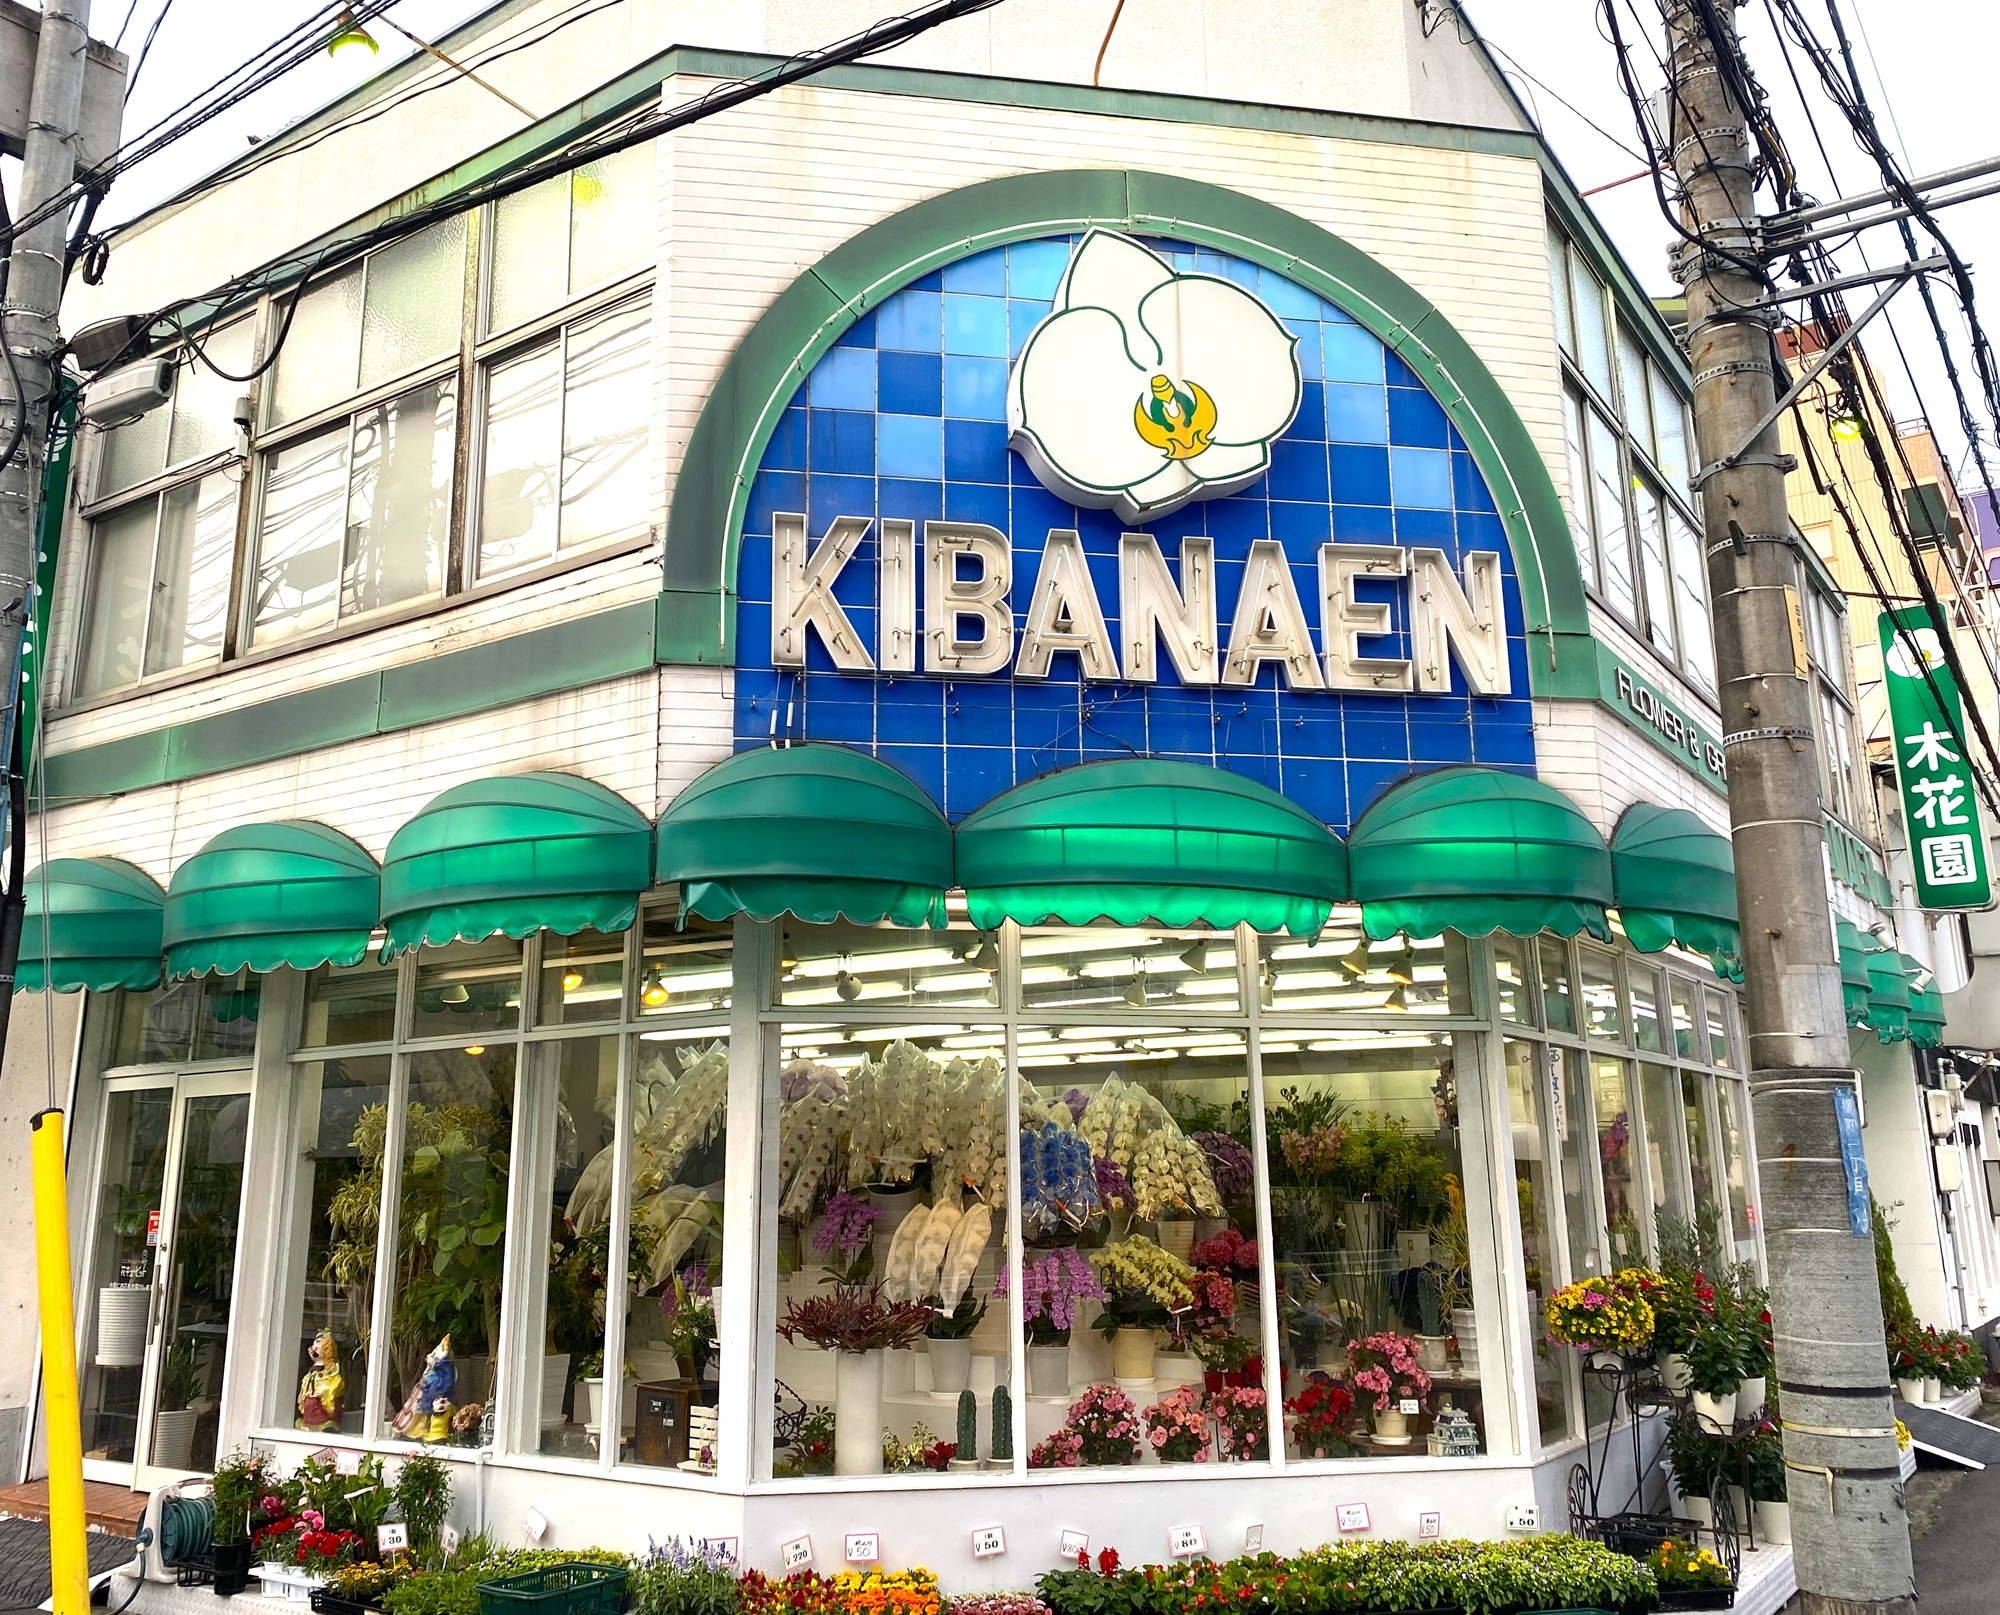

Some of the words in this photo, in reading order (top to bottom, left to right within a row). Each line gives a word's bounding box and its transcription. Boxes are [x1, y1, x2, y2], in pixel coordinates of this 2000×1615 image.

[771, 511, 1512, 697] KIBANAEN
[1614, 667, 1687, 749] FLOWER
[1686, 726, 1700, 761] &
[1904, 721, 1978, 886] 木花園
